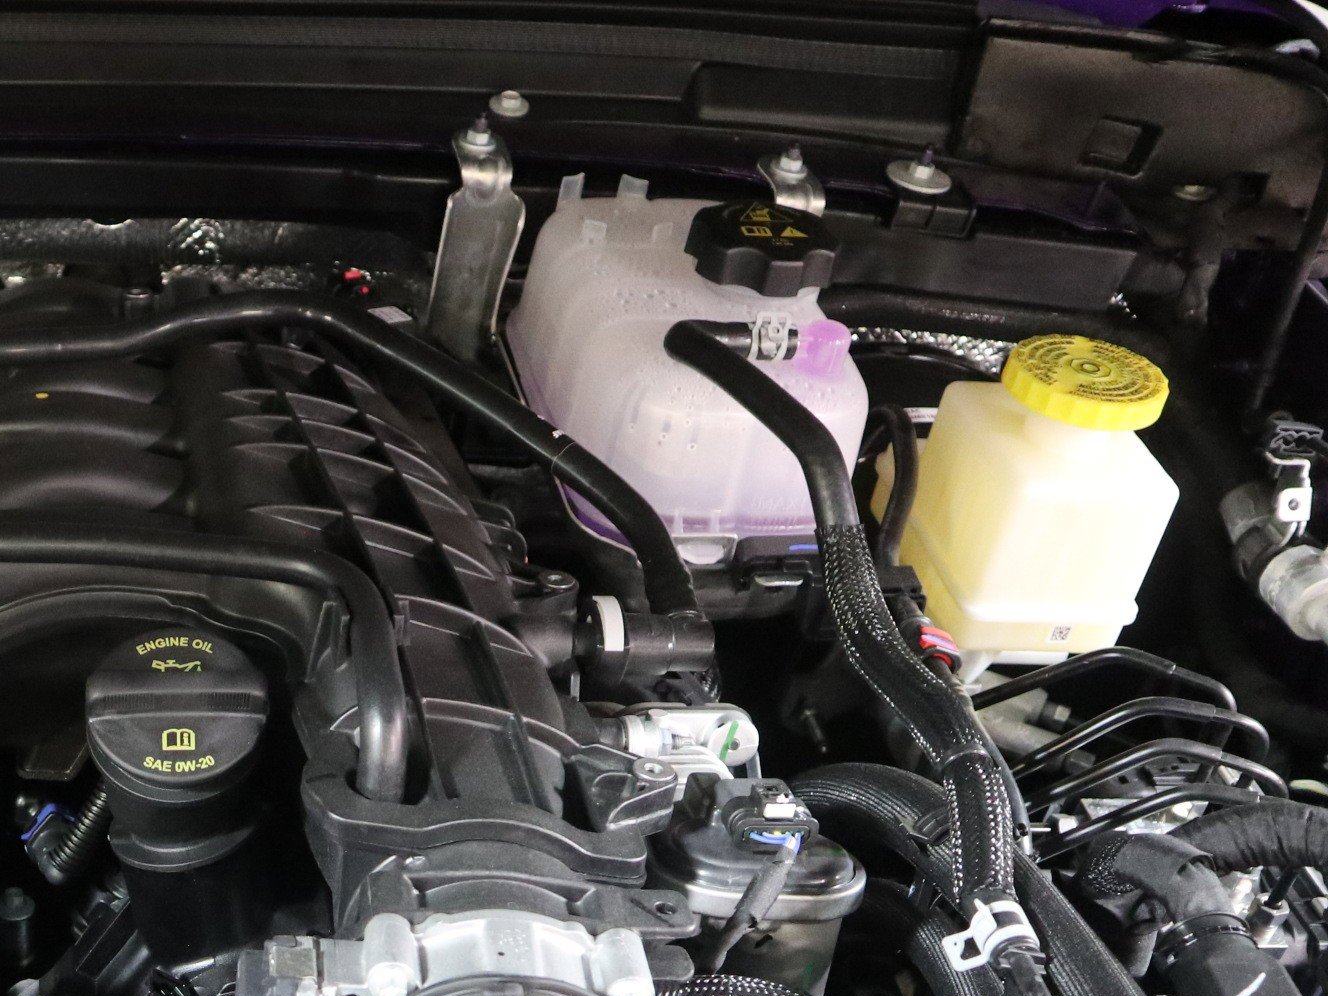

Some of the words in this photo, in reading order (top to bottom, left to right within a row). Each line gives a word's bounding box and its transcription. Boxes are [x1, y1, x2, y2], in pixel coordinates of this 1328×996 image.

[136, 636, 189, 656] ENGINE
[192, 639, 213, 654] OIL
[143, 755, 172, 772] SAE
[174, 755, 215, 772] 0W-20
